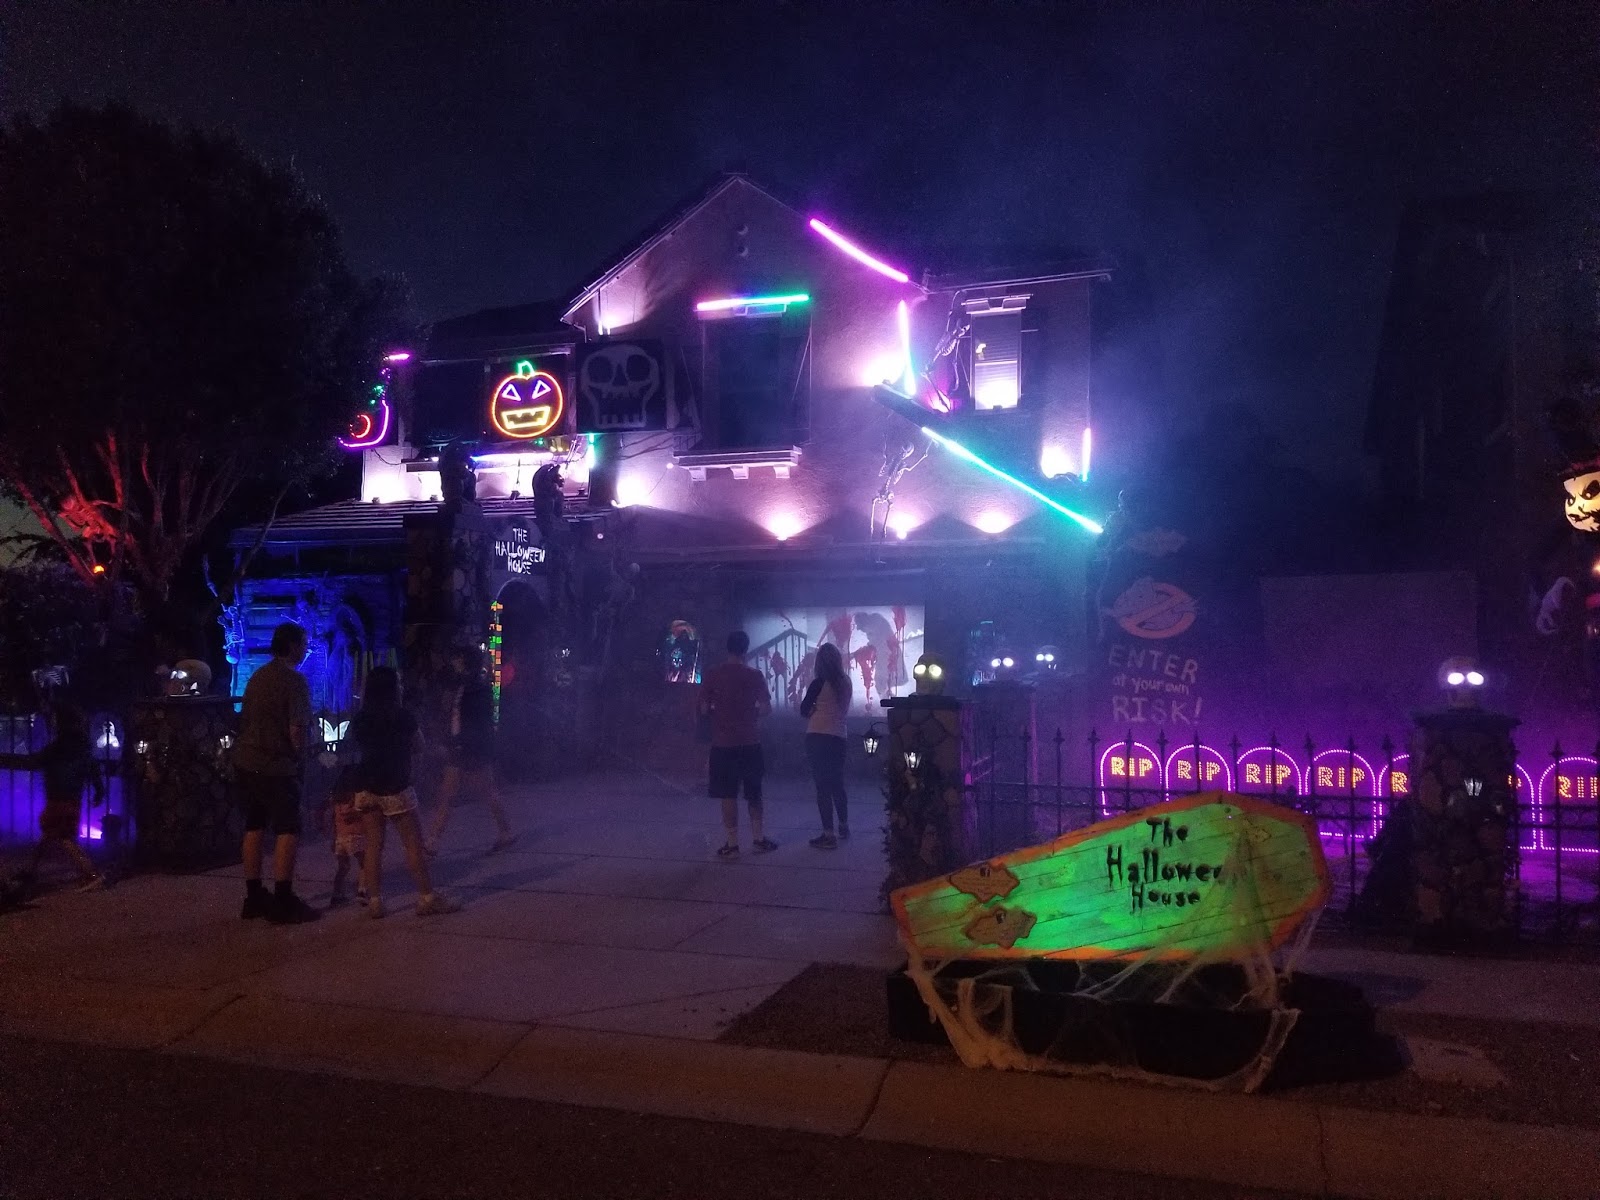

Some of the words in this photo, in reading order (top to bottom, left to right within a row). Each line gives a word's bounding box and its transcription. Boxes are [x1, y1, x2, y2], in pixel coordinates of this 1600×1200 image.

[512, 527, 528, 543] THE
[494, 540, 546, 563] HALLOWEEN
[507, 556, 533, 575] HOUSE
[1108, 644, 1199, 684] ENTER
[1112, 672, 1127, 687] at
[1131, 677, 1164, 694] your
[1165, 682, 1190, 696] own
[1112, 695, 1203, 725] RISK!
[1110, 756, 1153, 778] RIP
[1177, 760, 1221, 782] RIP
[1245, 763, 1292, 785] RIP
[1317, 766, 1366, 789] RIP
[1146, 816, 1188, 847] The
[1130, 882, 1200, 914] House
